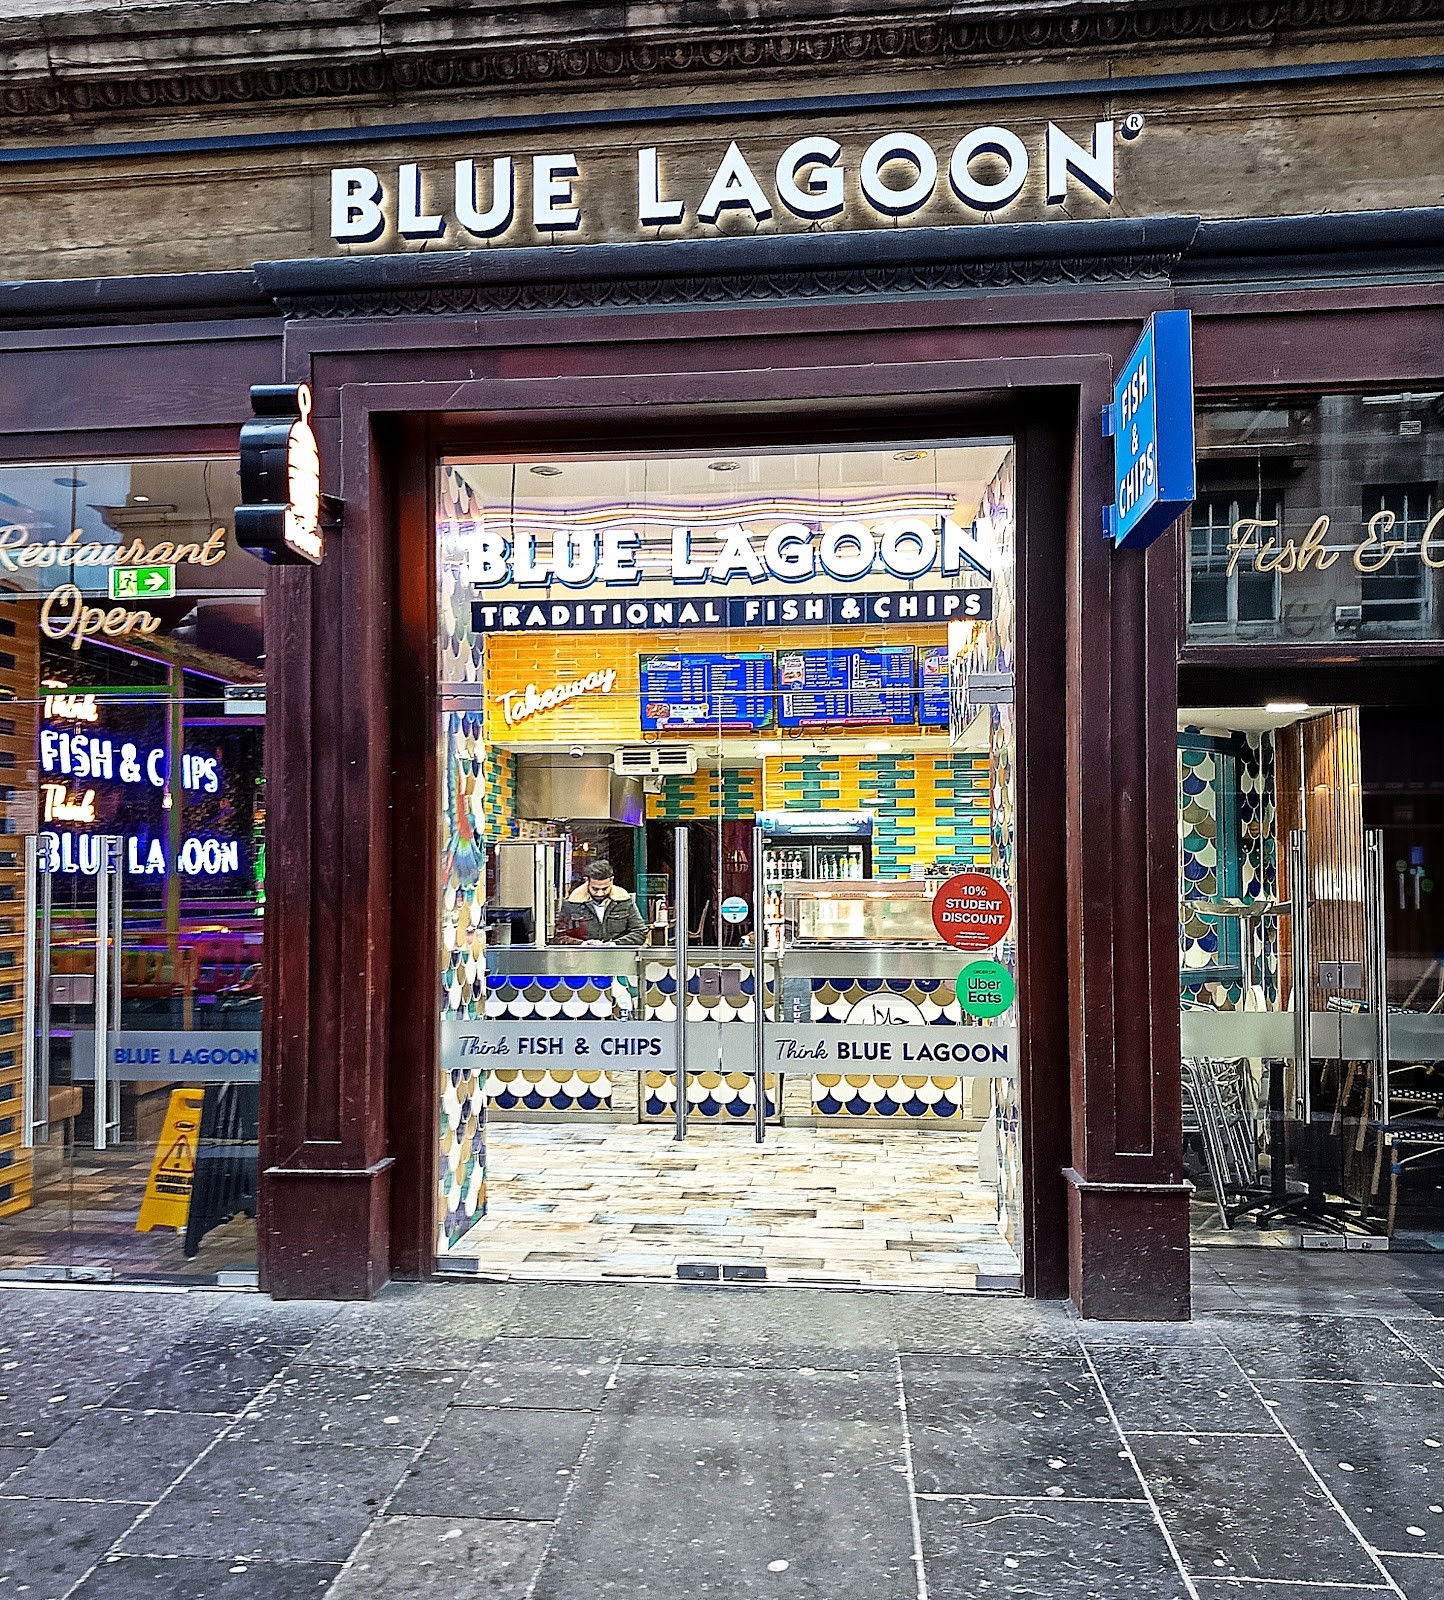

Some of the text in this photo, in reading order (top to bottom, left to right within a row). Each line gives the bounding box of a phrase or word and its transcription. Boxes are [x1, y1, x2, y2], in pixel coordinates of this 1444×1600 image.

[330, 154, 580, 243] BLUE
[638, 120, 1115, 226] LAGOON
[1121, 355, 1148, 431] FISH
[1131, 423, 1139, 456] &
[1119, 442, 1154, 519] CHIPS
[0, 524, 226, 572] Restaurant
[468, 515, 993, 589] BLUE LAGOON
[1226, 514, 1339, 578] Fish
[1354, 510, 1405, 572] &
[40, 583, 162, 651] Open
[480, 593, 981, 627] TRADITIONAL FISH & CHIPS
[495, 667, 617, 725] Takeaway
[40, 730, 218, 793] FISH & CIPS
[128, 836, 239, 875] LAOON
[945, 899, 1003, 911] STUDENT
[961, 886, 987, 897] 10%
[942, 912, 1005, 925] DISCOUNT
[967, 977, 1001, 990] Uber
[968, 991, 1002, 1004] Eats
[114, 1047, 259, 1064] BLUE LAGOON
[458, 1035, 662, 1057] Think FISH & CHIPS
[775, 1039, 1009, 1063] Think BLUE LAGOON
